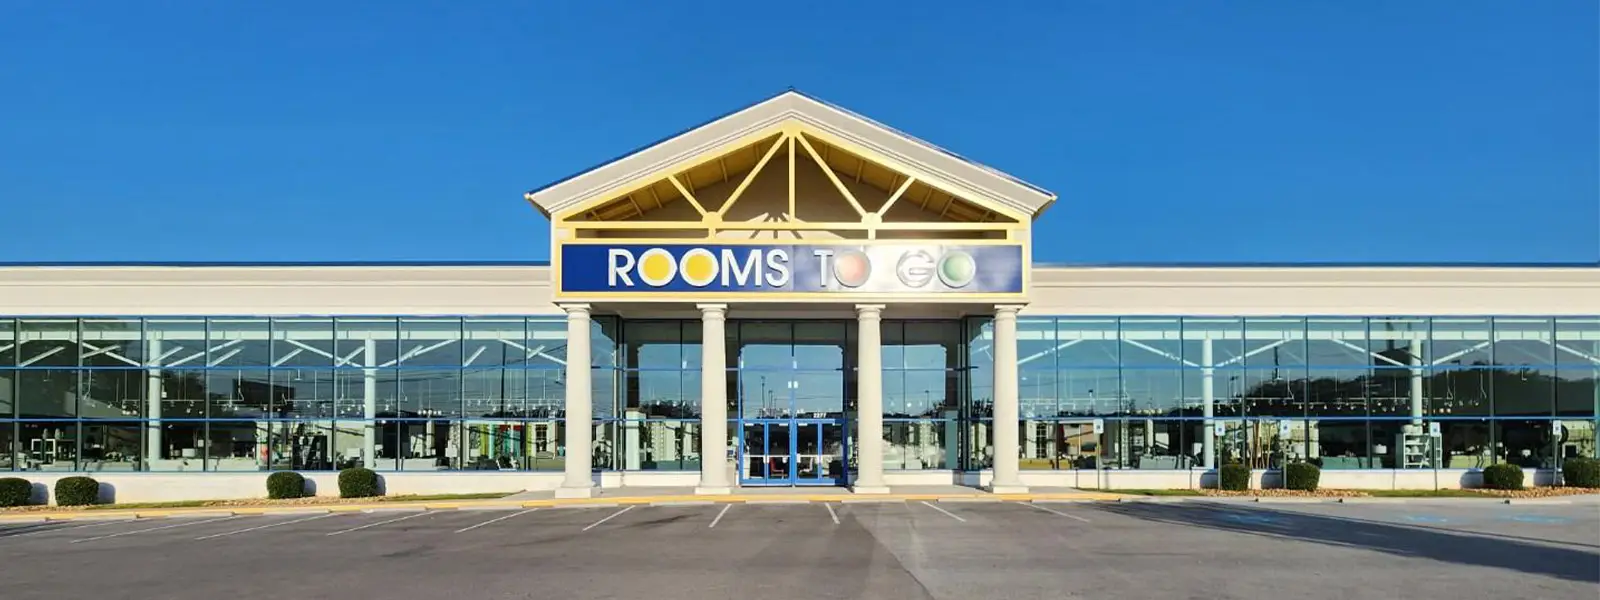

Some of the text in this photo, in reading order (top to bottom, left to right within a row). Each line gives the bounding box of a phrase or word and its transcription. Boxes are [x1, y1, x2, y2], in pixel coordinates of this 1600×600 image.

[608, 248, 976, 288] ROOMS TO GO
